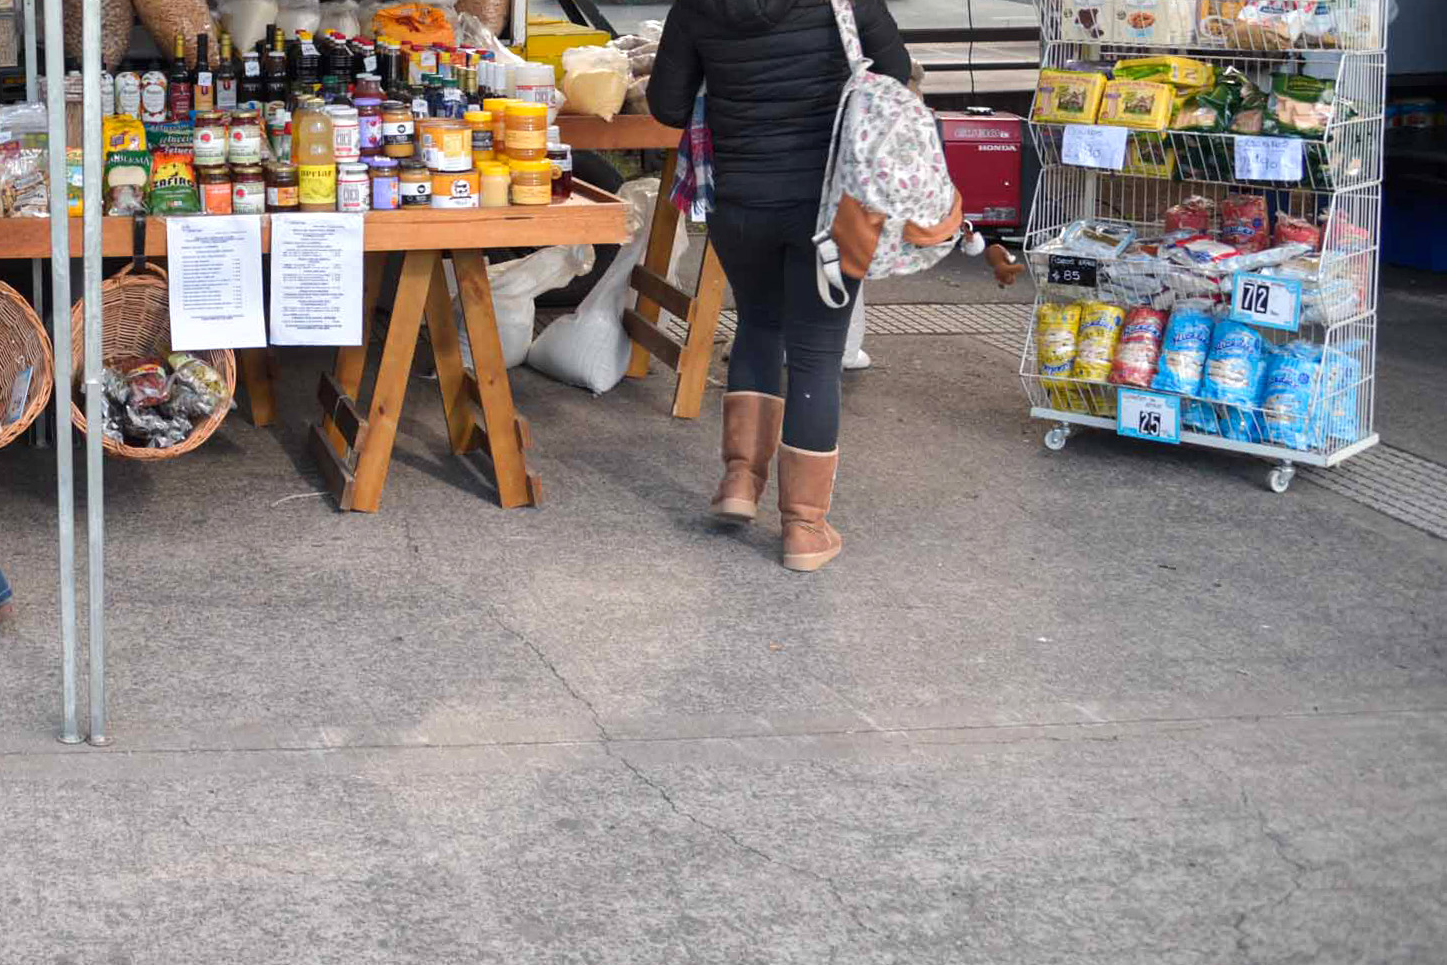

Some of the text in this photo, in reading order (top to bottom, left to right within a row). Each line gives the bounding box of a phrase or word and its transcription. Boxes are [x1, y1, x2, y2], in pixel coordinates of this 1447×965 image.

[978, 144, 1017, 152] HONDA
[1063, 269, 1081, 281] 85
[1242, 283, 1269, 314] 72
[1139, 411, 1161, 435] 25
